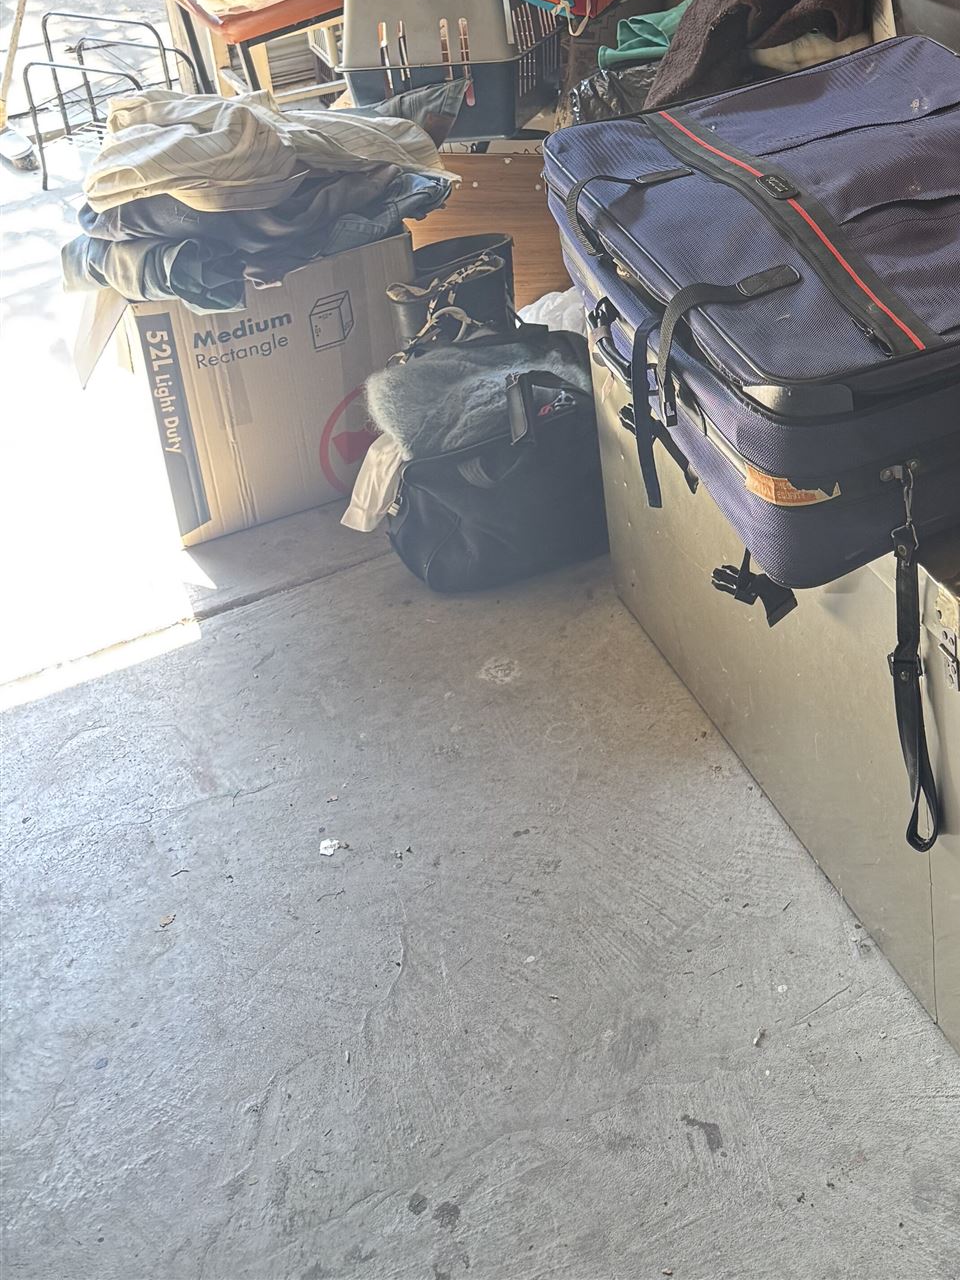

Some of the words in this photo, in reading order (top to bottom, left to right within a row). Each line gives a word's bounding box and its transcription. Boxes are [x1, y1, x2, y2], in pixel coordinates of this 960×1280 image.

[193, 312, 293, 349] Medium
[145, 330, 174, 372] 52L
[195, 333, 289, 370] Rectangle
[154, 373, 177, 413] Light
[163, 416, 183, 454] Duty
